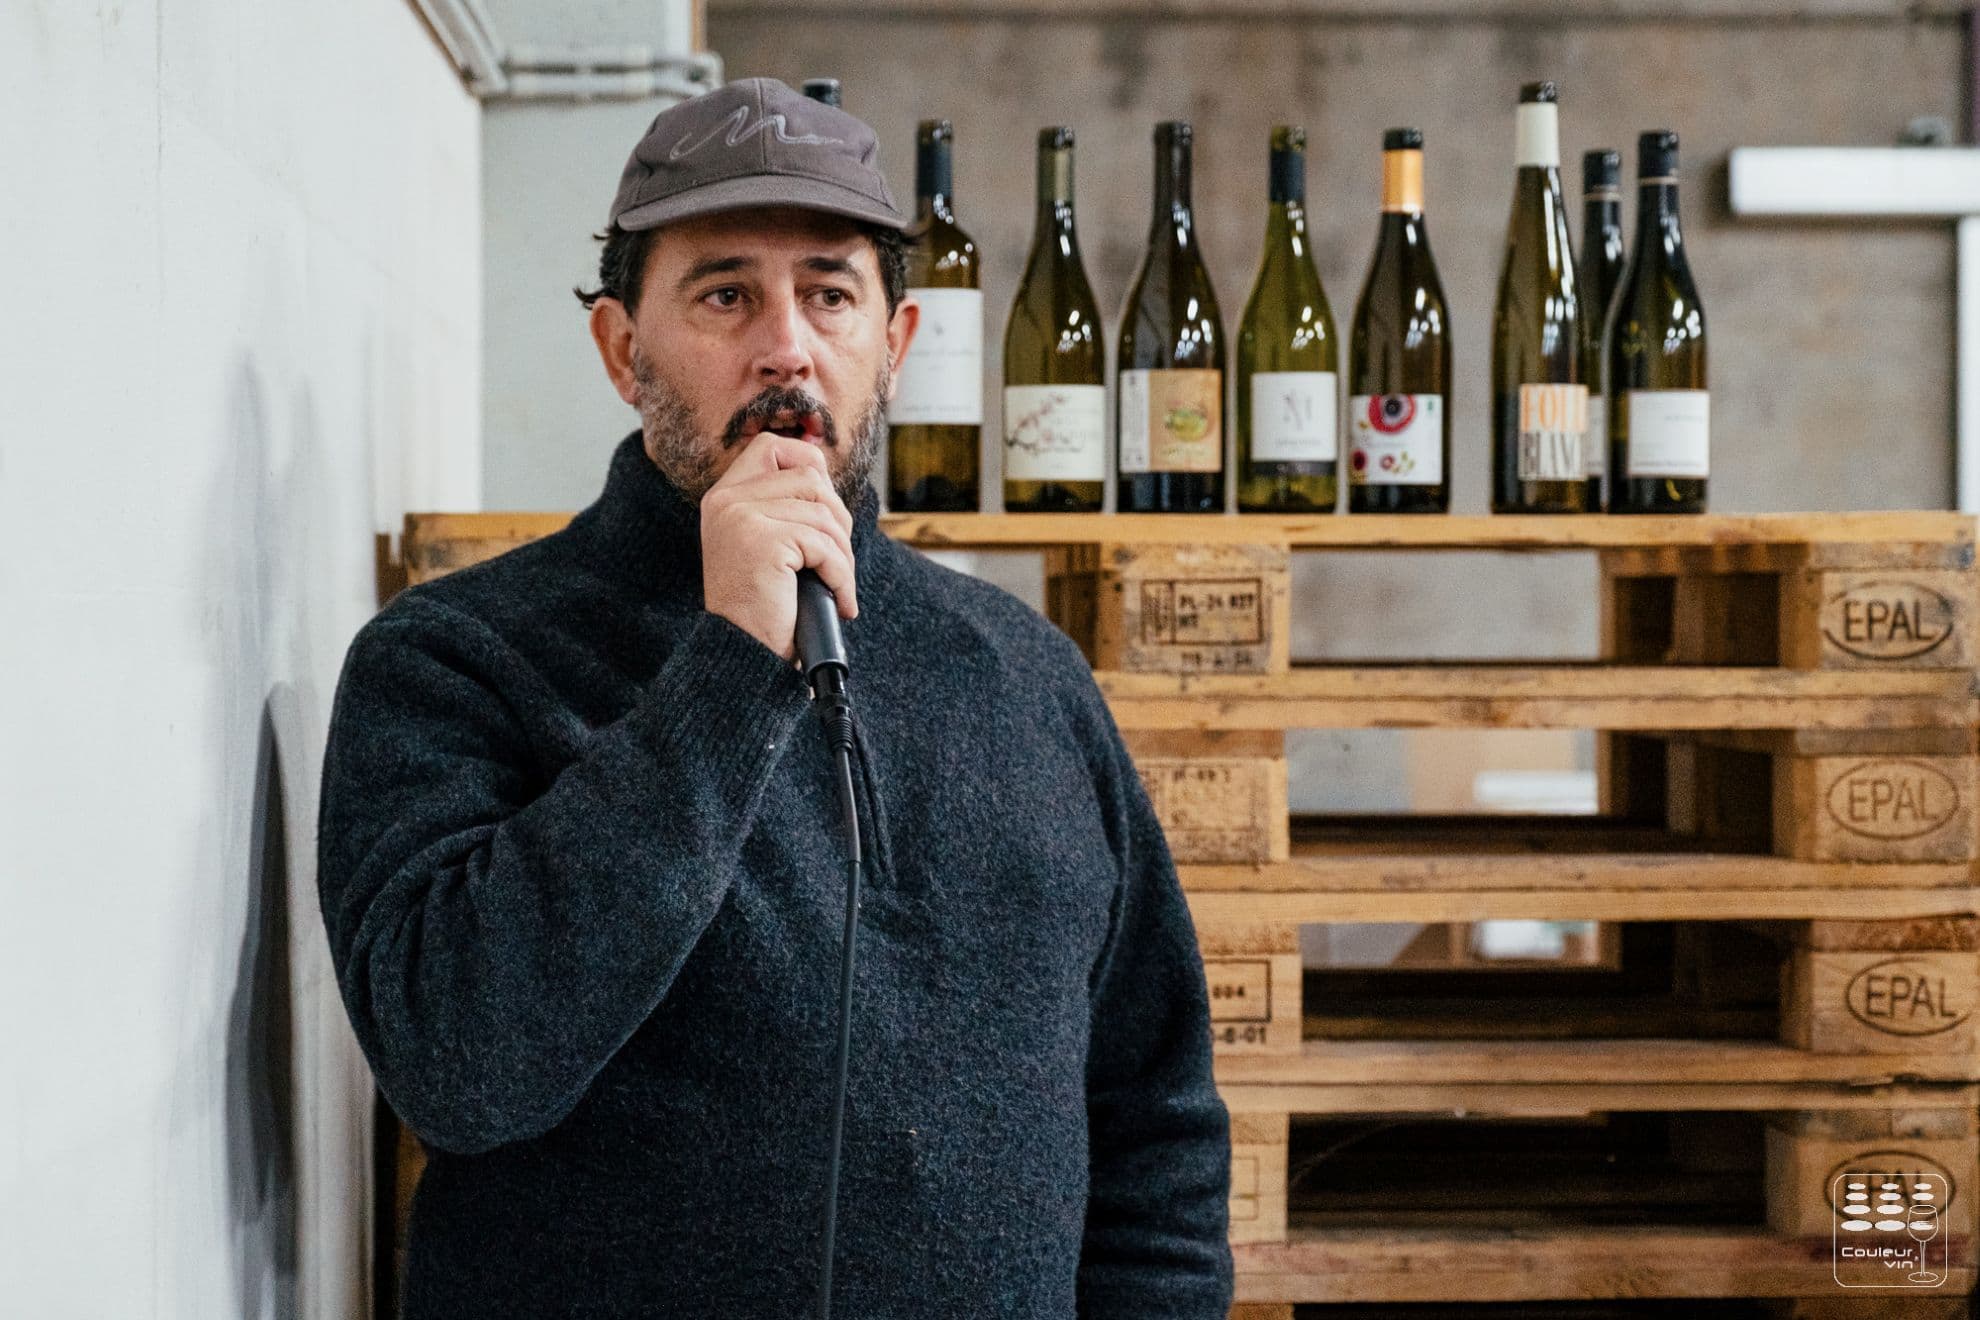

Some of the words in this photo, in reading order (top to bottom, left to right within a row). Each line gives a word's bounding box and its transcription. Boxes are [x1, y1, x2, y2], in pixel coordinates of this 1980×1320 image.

[1844, 599, 1939, 642] EPAL
[1848, 777, 1938, 822] EPAL
[1866, 974, 1958, 1018] EPAL
